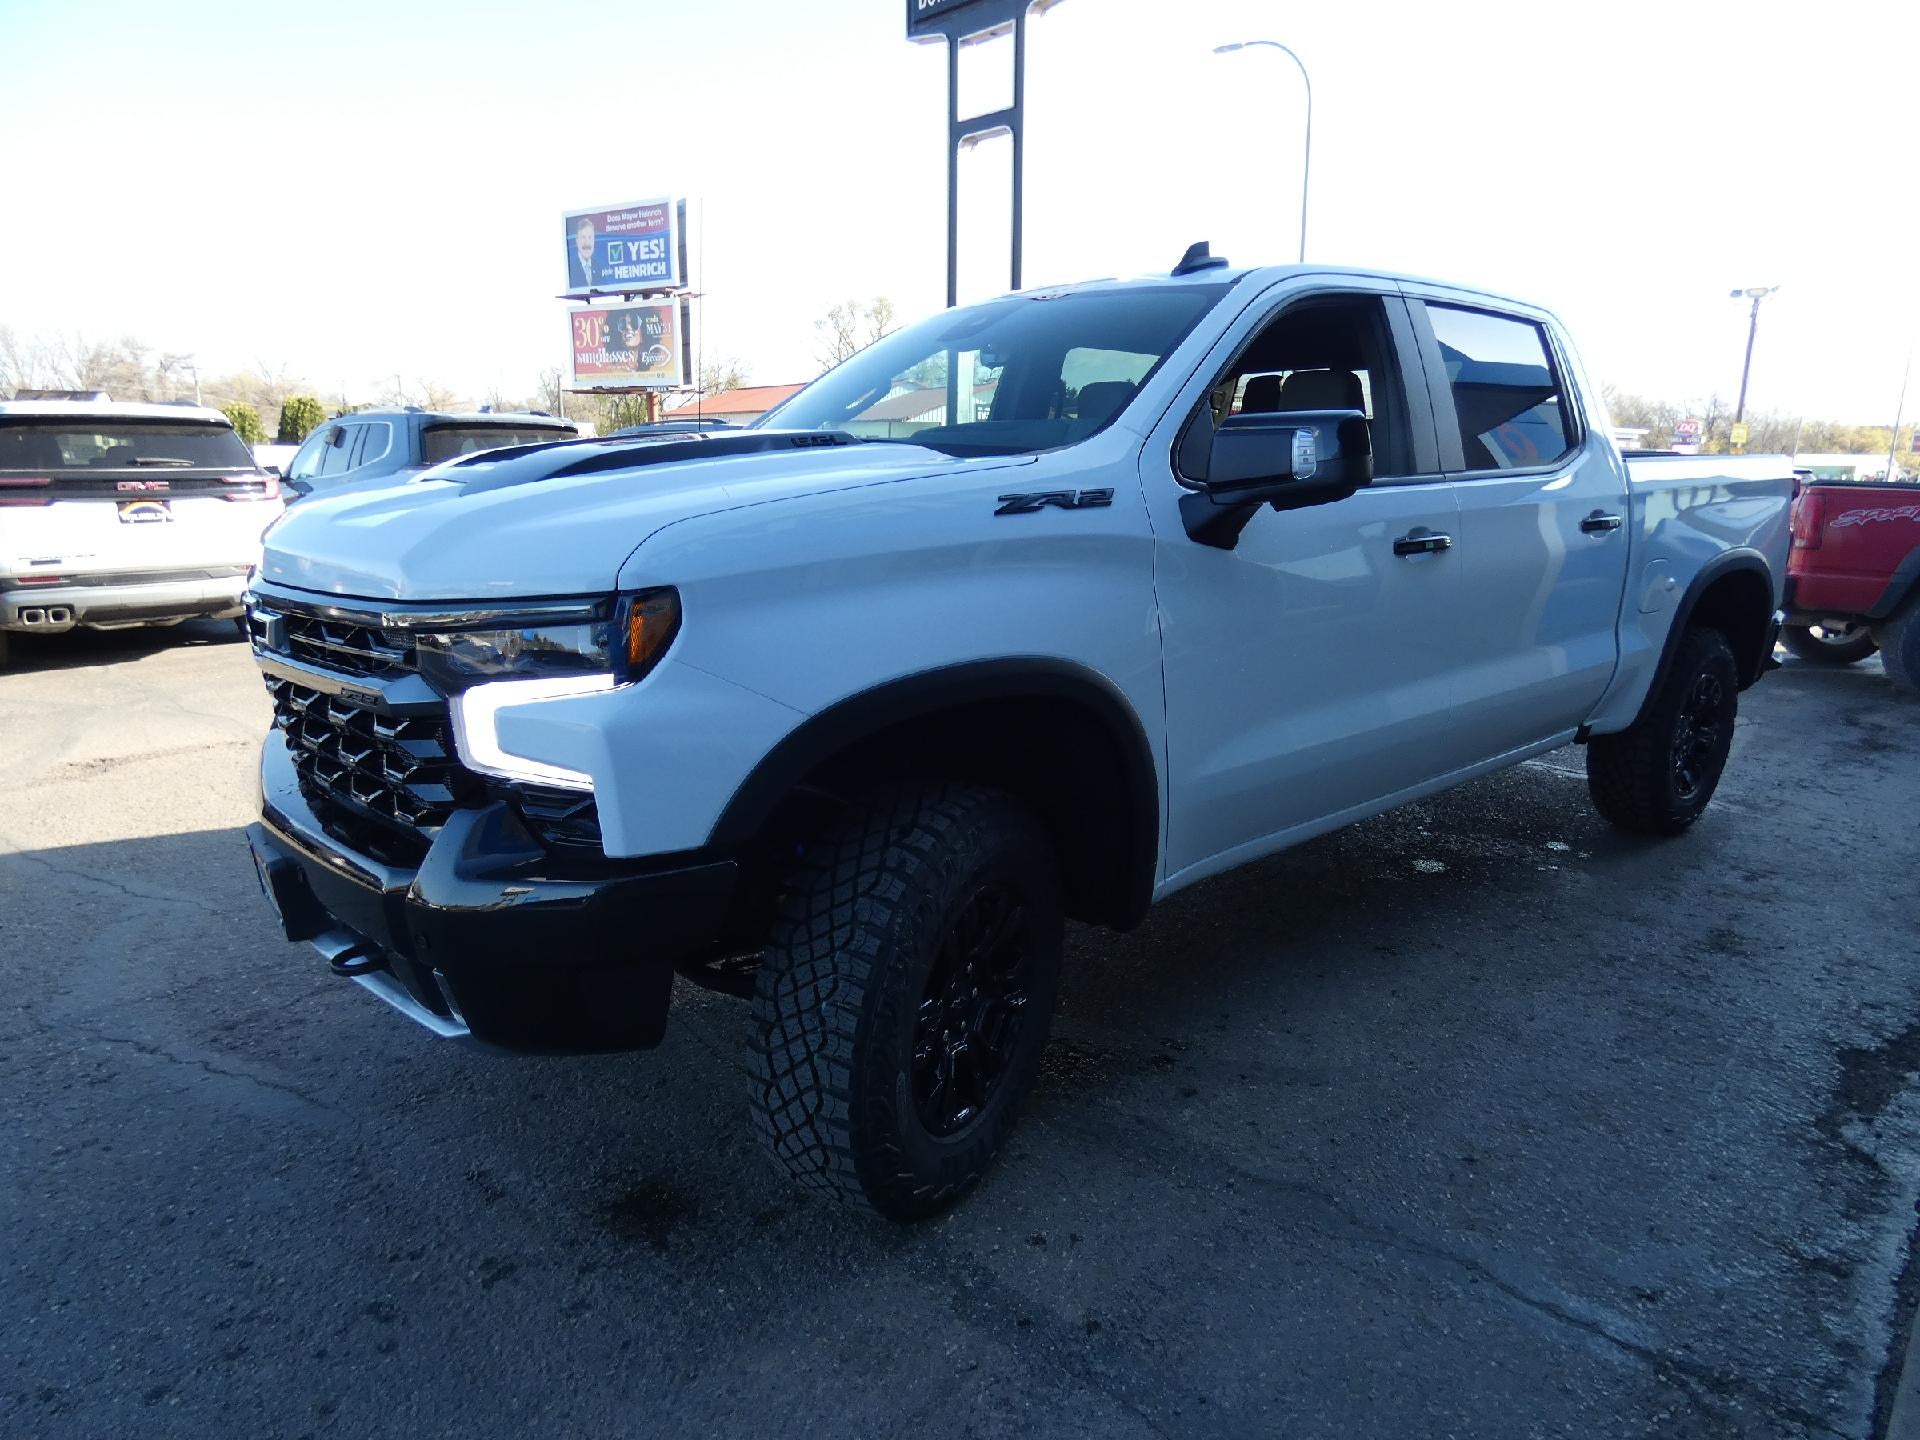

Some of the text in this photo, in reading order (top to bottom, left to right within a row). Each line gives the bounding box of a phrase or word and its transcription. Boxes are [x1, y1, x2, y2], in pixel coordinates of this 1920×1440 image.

[622, 212, 638, 221] Mayor
[627, 238, 665, 261] YES!
[615, 262, 666, 279] HEINRICH
[647, 323, 662, 335] MAY
[577, 348, 635, 368] sunglasses
[117, 481, 170, 491] GMC
[993, 488, 1115, 516] ZR2
